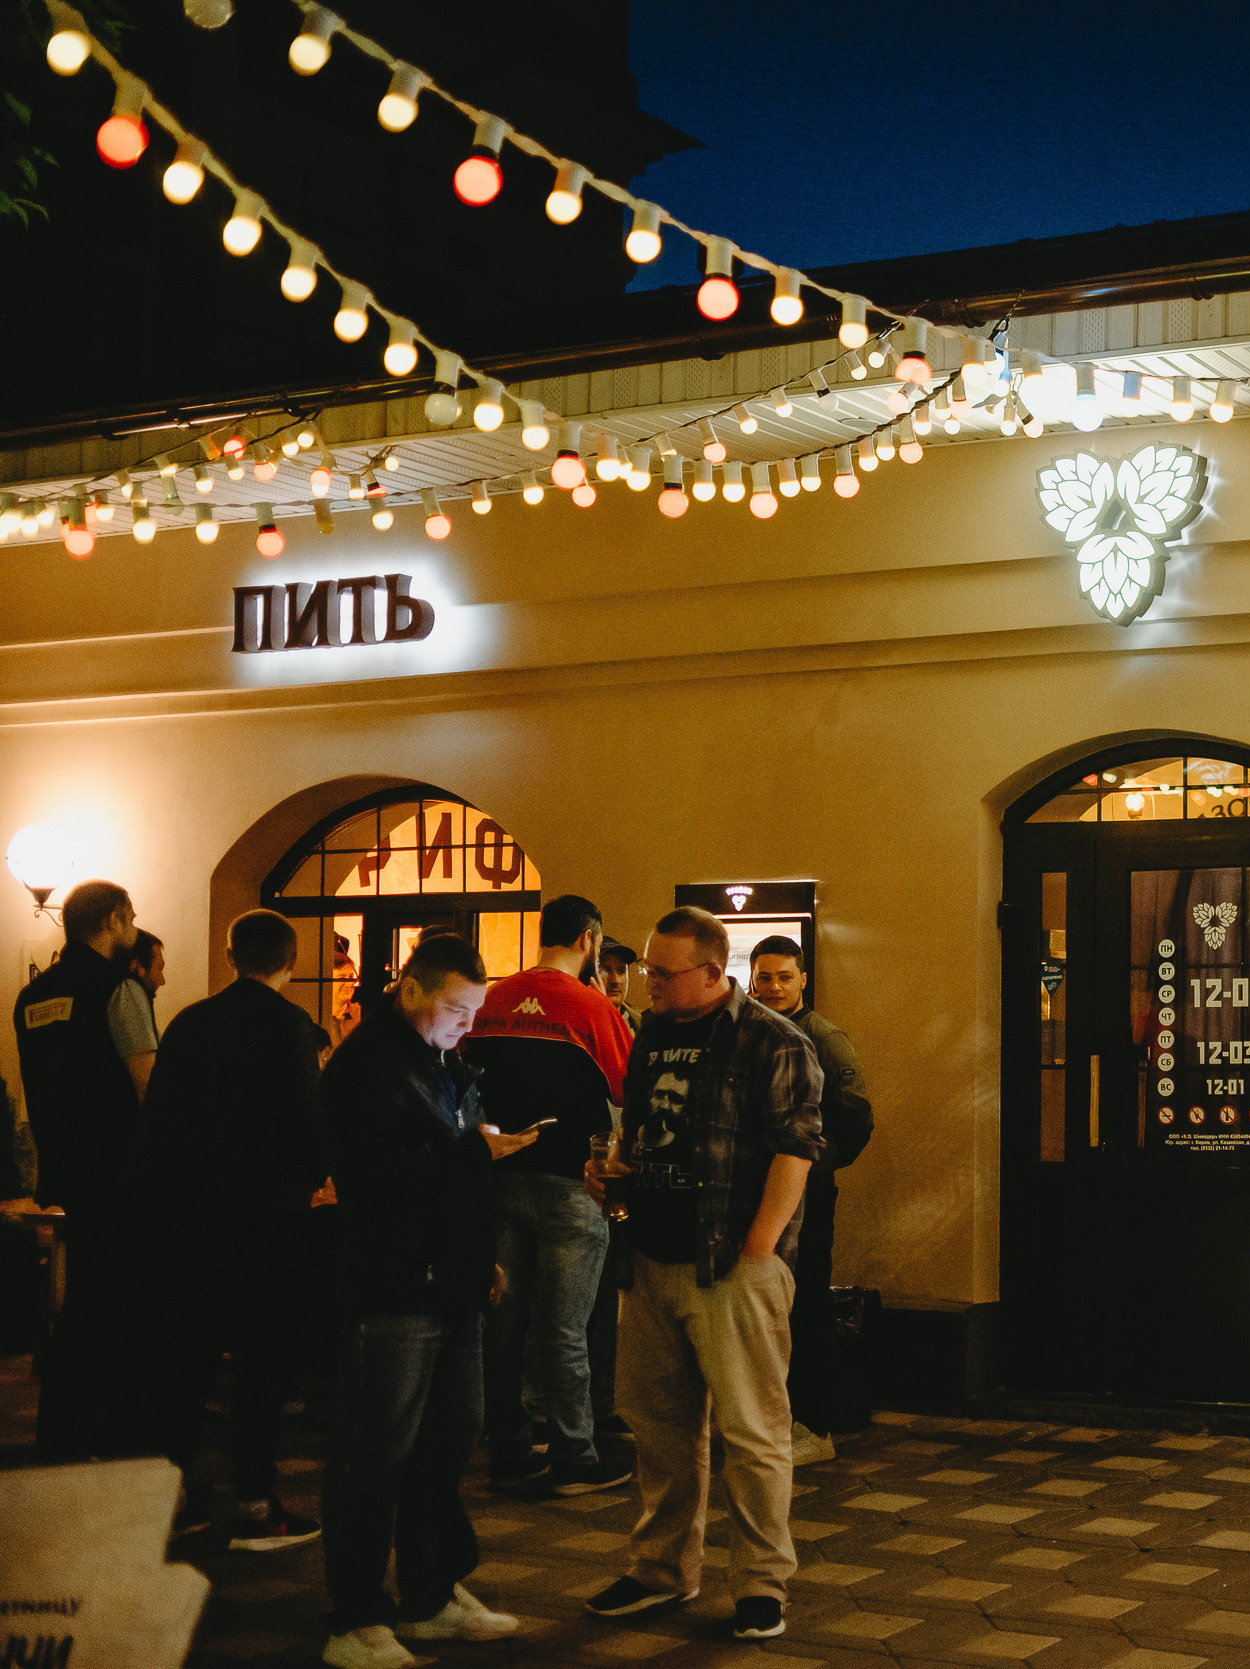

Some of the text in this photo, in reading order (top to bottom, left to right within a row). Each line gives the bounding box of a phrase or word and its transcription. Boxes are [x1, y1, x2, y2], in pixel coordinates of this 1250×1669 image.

[231, 573, 435, 654] ПИТЬ
[1160, 944, 1172, 953] ПН
[1161, 968, 1172, 976] ВТ
[1161, 990, 1172, 998] СР
[1161, 1013, 1172, 1021] ЧТ
[1160, 1036, 1172, 1044] ПТ
[1160, 1058, 1172, 1066] СБ
[1160, 1083, 1172, 1091] ВС
[1206, 1079, 1245, 1095] 12-01
